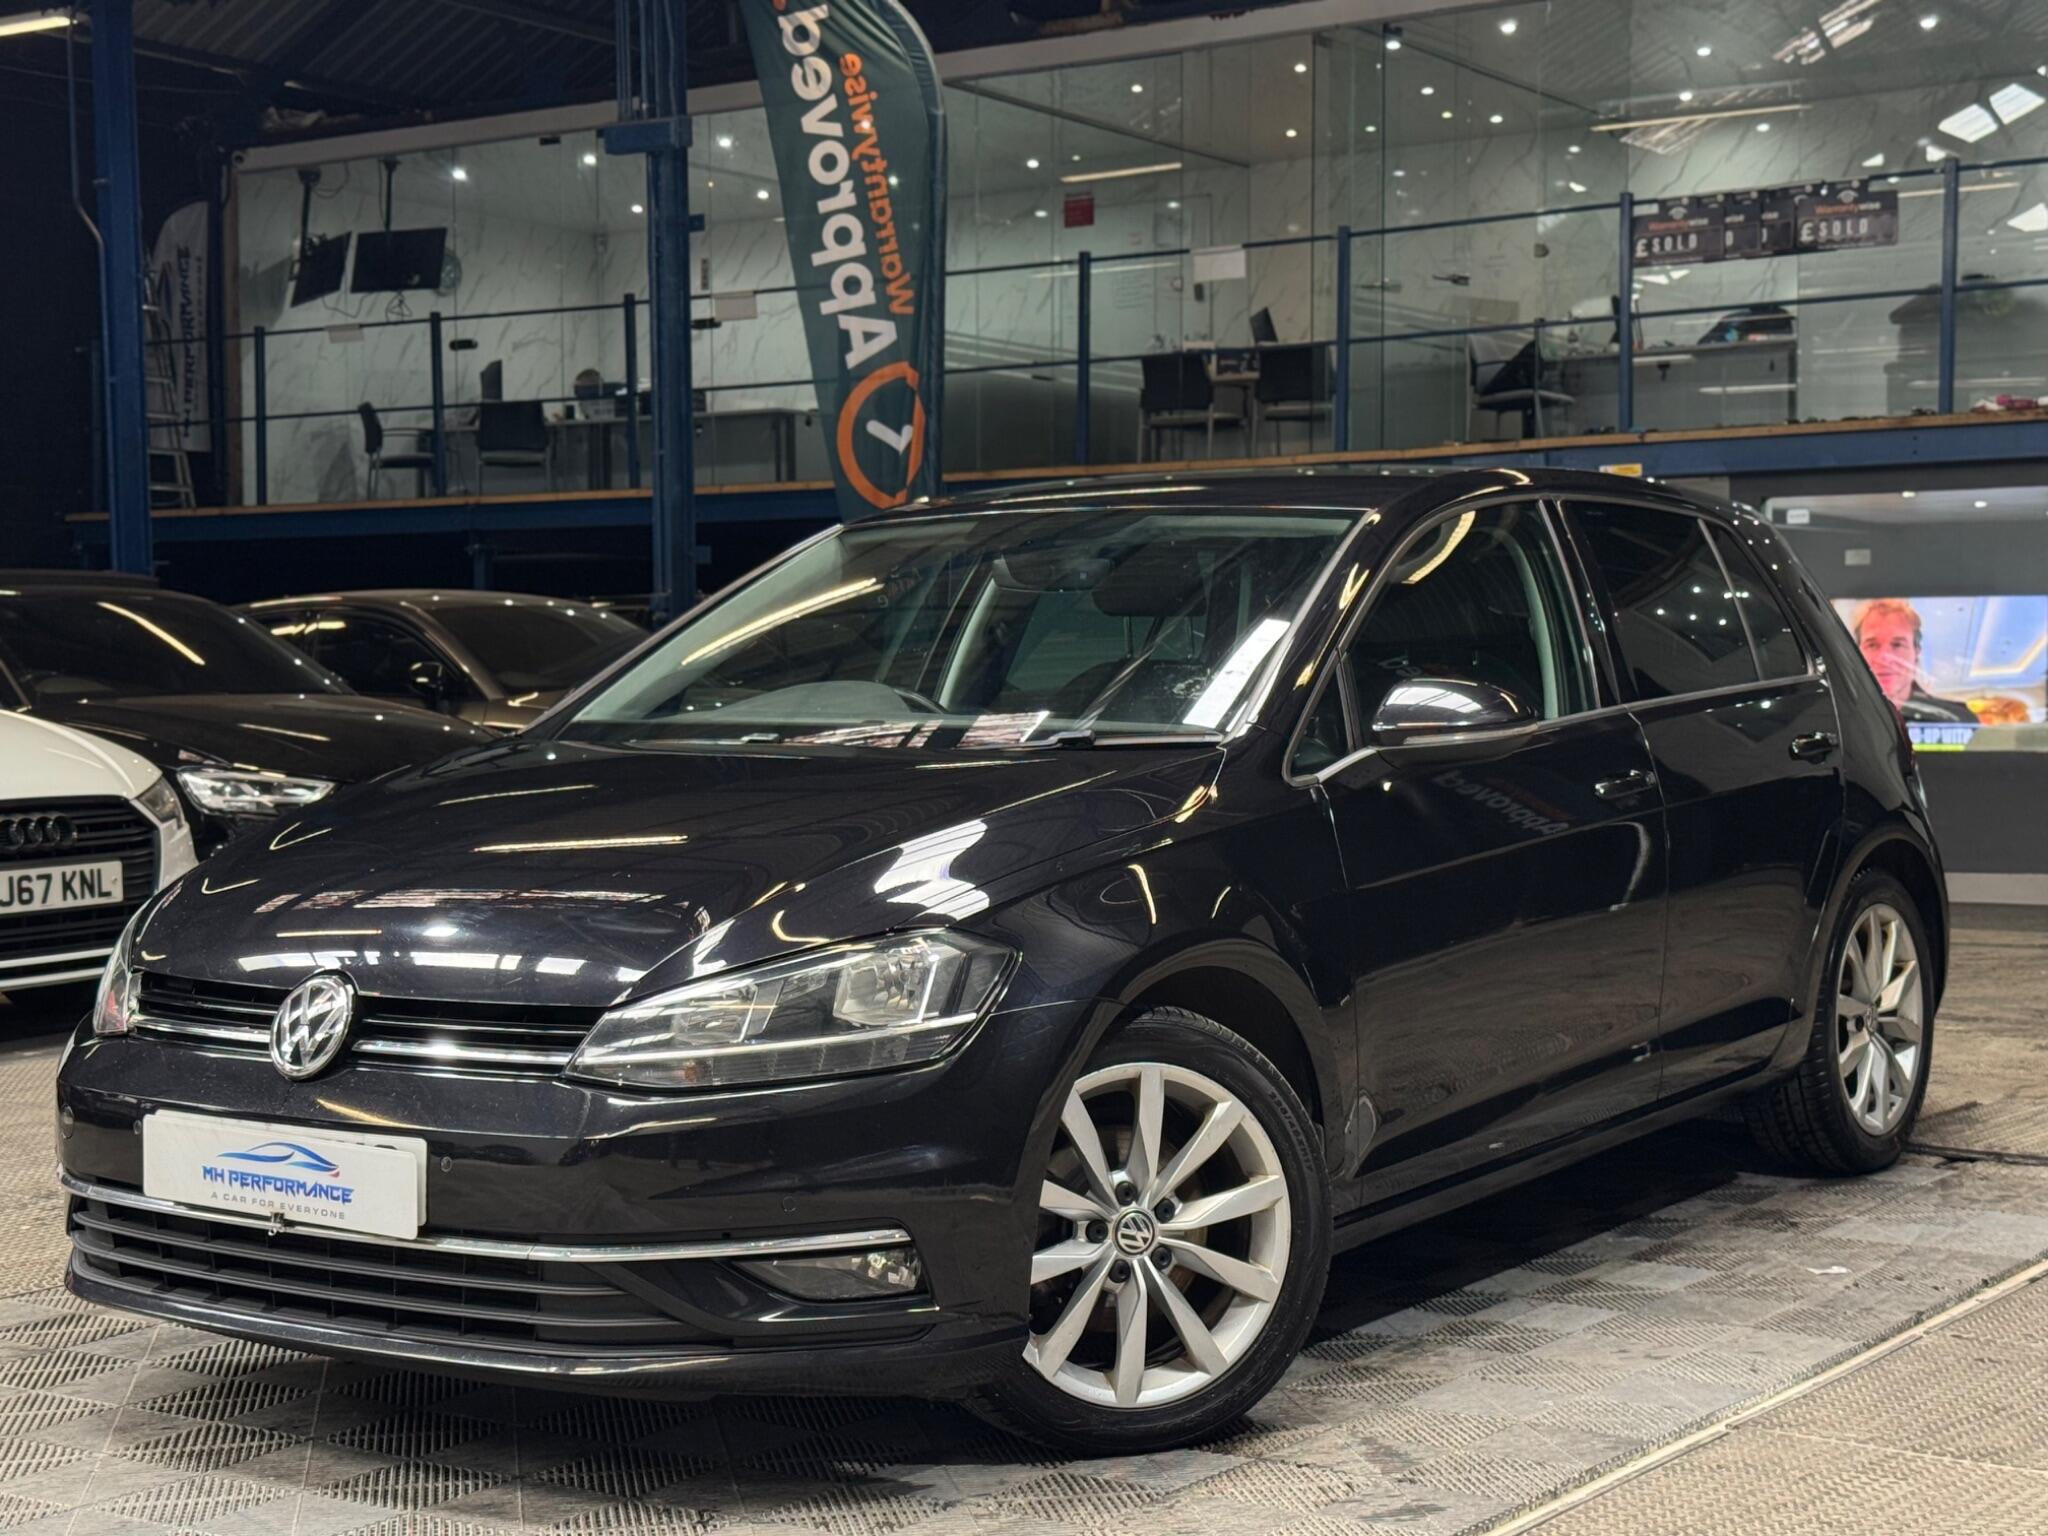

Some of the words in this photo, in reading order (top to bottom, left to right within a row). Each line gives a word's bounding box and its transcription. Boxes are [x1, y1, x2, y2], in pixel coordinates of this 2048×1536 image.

[61, 867, 113, 902] KNL
[202, 1165, 225, 1184] MH
[228, 1169, 355, 1205] PERFORMANCE
[210, 1191, 218, 1199] A
[223, 1193, 247, 1204] CAR
[251, 1199, 275, 1209] FOR
[279, 1202, 346, 1220] EVERYONE
